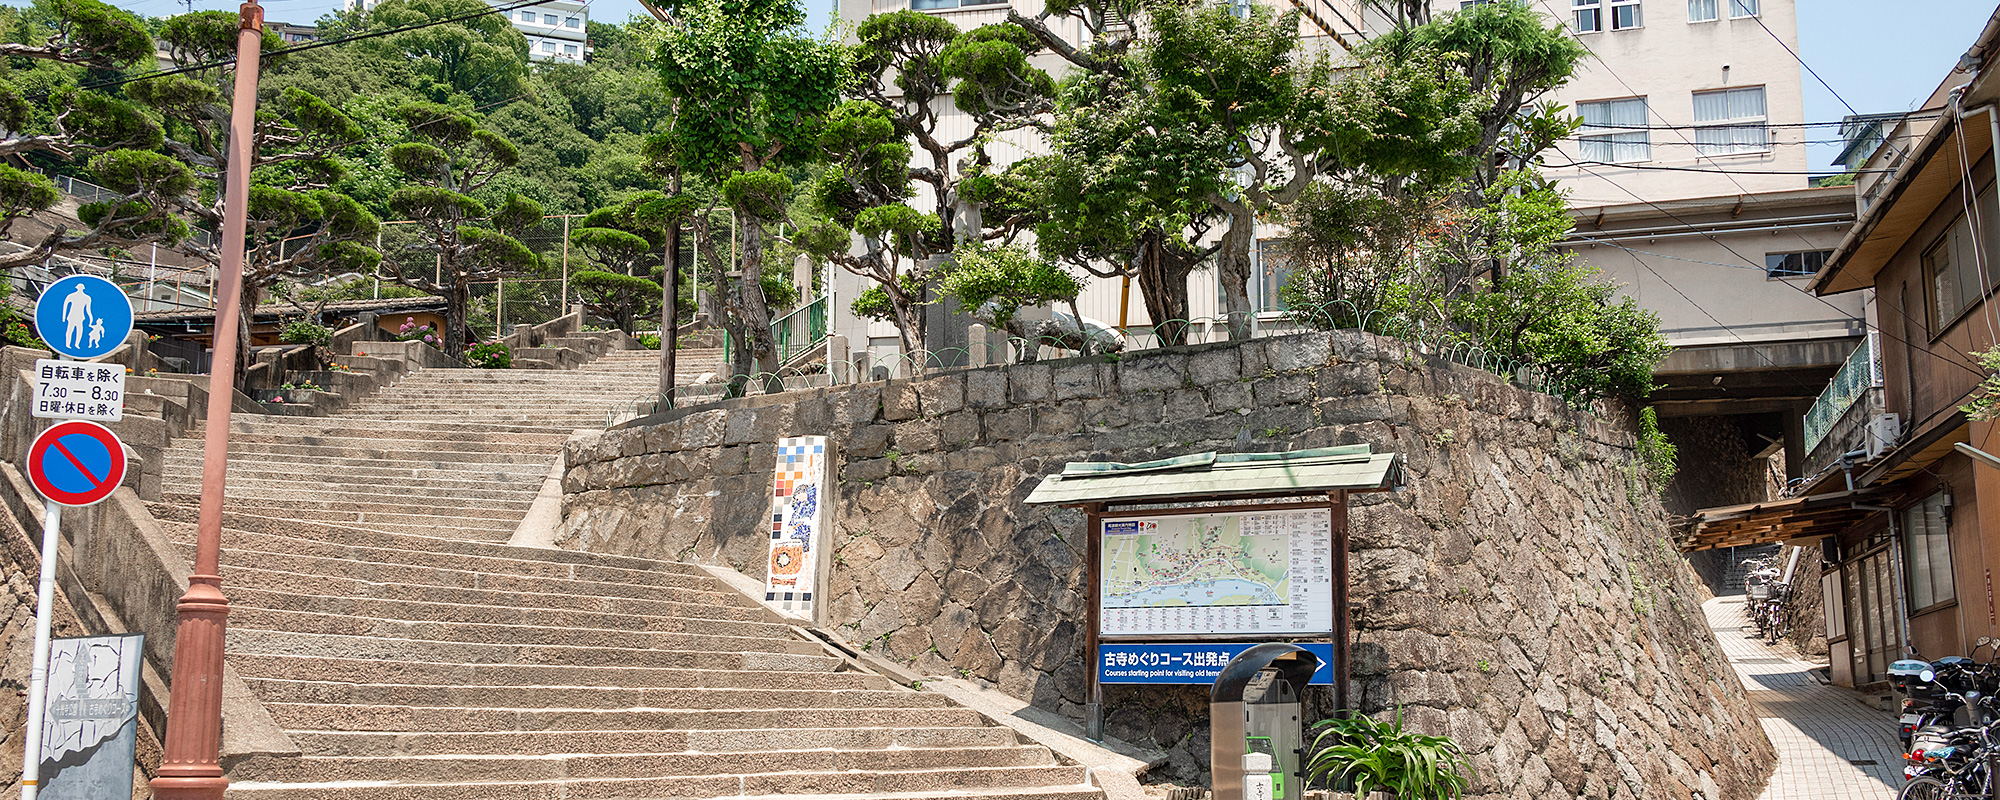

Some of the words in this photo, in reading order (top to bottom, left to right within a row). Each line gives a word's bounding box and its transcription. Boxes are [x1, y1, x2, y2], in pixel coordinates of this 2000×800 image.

[42, 365, 119, 383] 自転車を除く
[40, 382, 67, 398] 7.30
[91, 386, 118, 401] 8.30
[1105, 652, 1230, 667] 古寺めぐりコース出発点
[1105, 669, 1127, 677] Courses
[1128, 669, 1149, 678] starting
[1150, 669, 1164, 678] point
[1165, 669, 1173, 677] for
[1174, 669, 1194, 679] visiting
[1195, 669, 1205, 677] old
